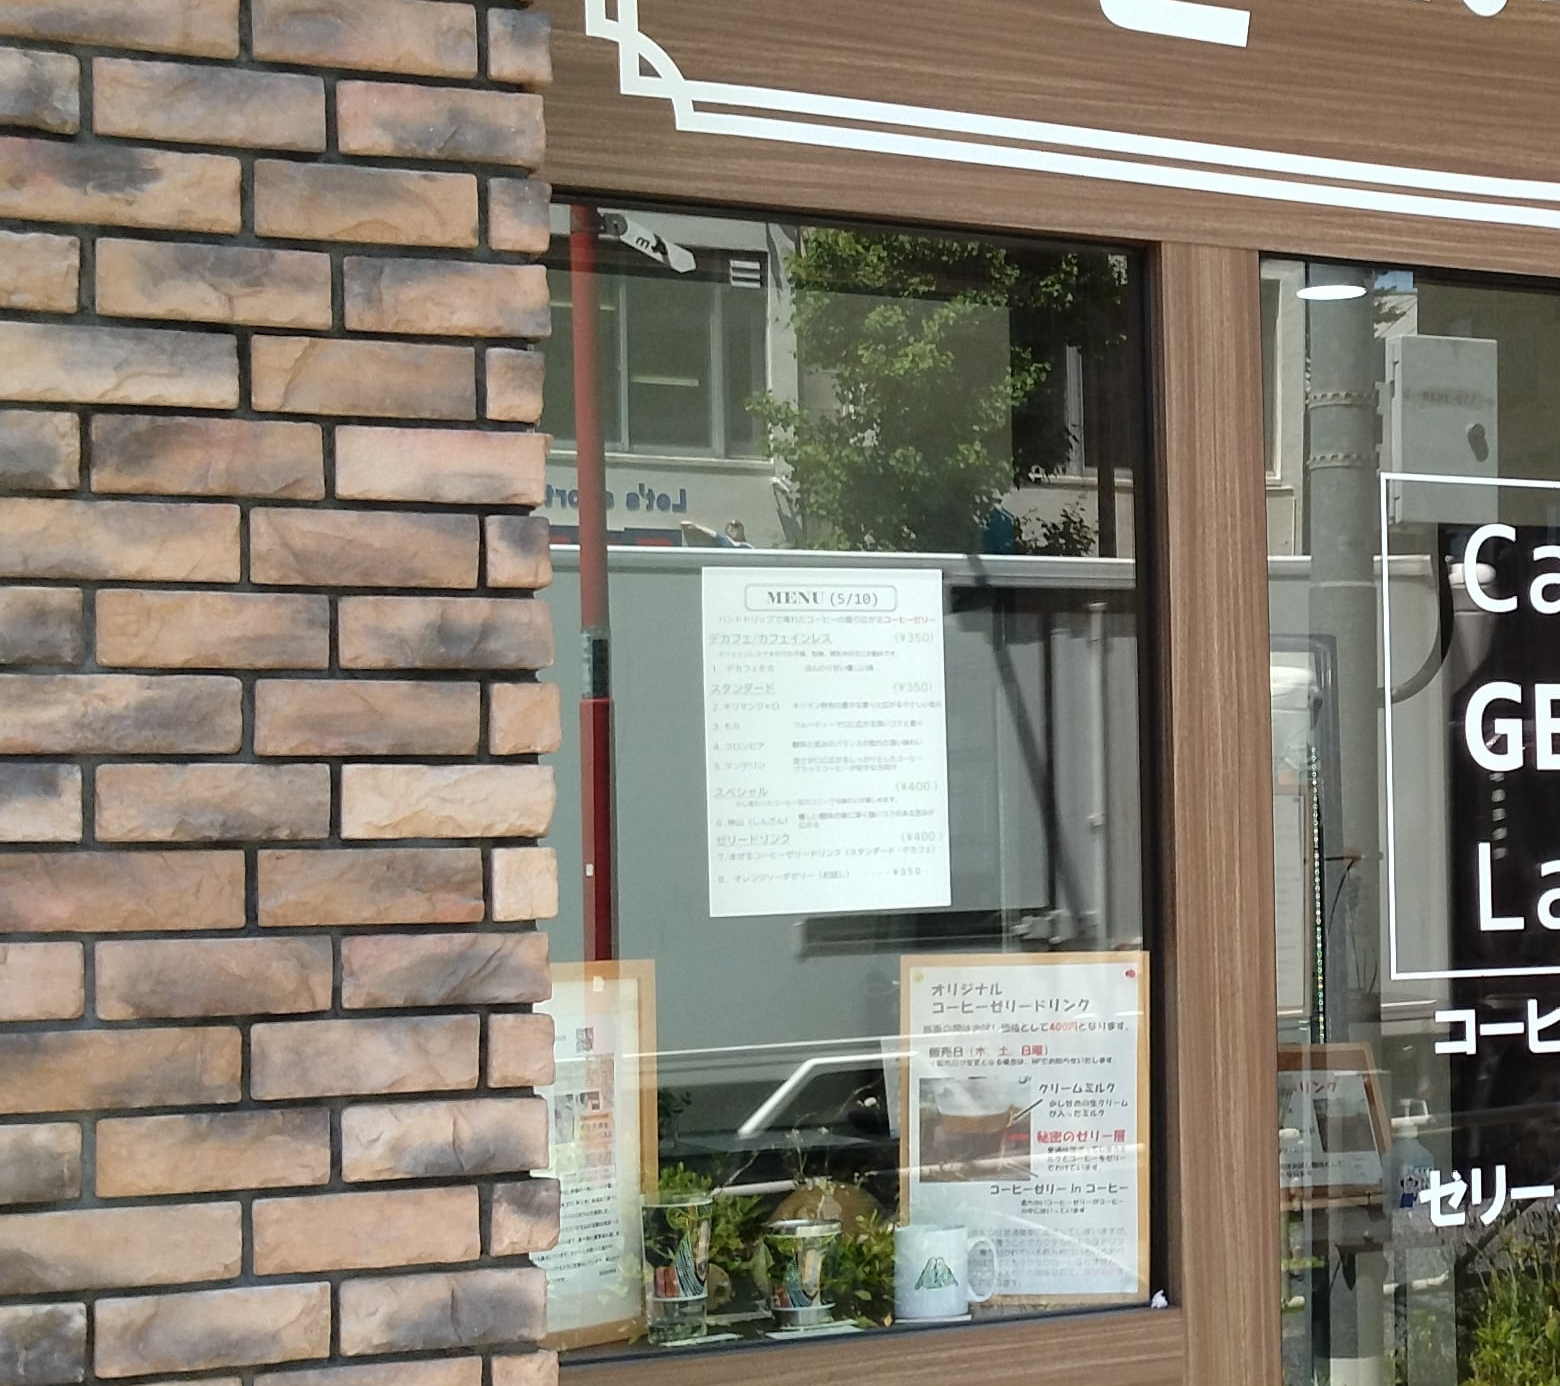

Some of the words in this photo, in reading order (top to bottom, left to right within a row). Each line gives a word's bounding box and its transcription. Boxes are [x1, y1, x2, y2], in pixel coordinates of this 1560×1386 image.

[767, 591, 824, 605] MENU
[830, 592, 878, 607] (5/10)
[931, 982, 1003, 997] オリジナル
[932, 998, 1091, 1014] コーヒーゼリードリンク
[1039, 1082, 1116, 1095] クリームミルク
[1036, 1129, 1127, 1144] 秘密のゼリー層
[989, 1183, 1067, 1196] コーヒーゼリー
[1085, 1183, 1129, 1195] コーヒー
